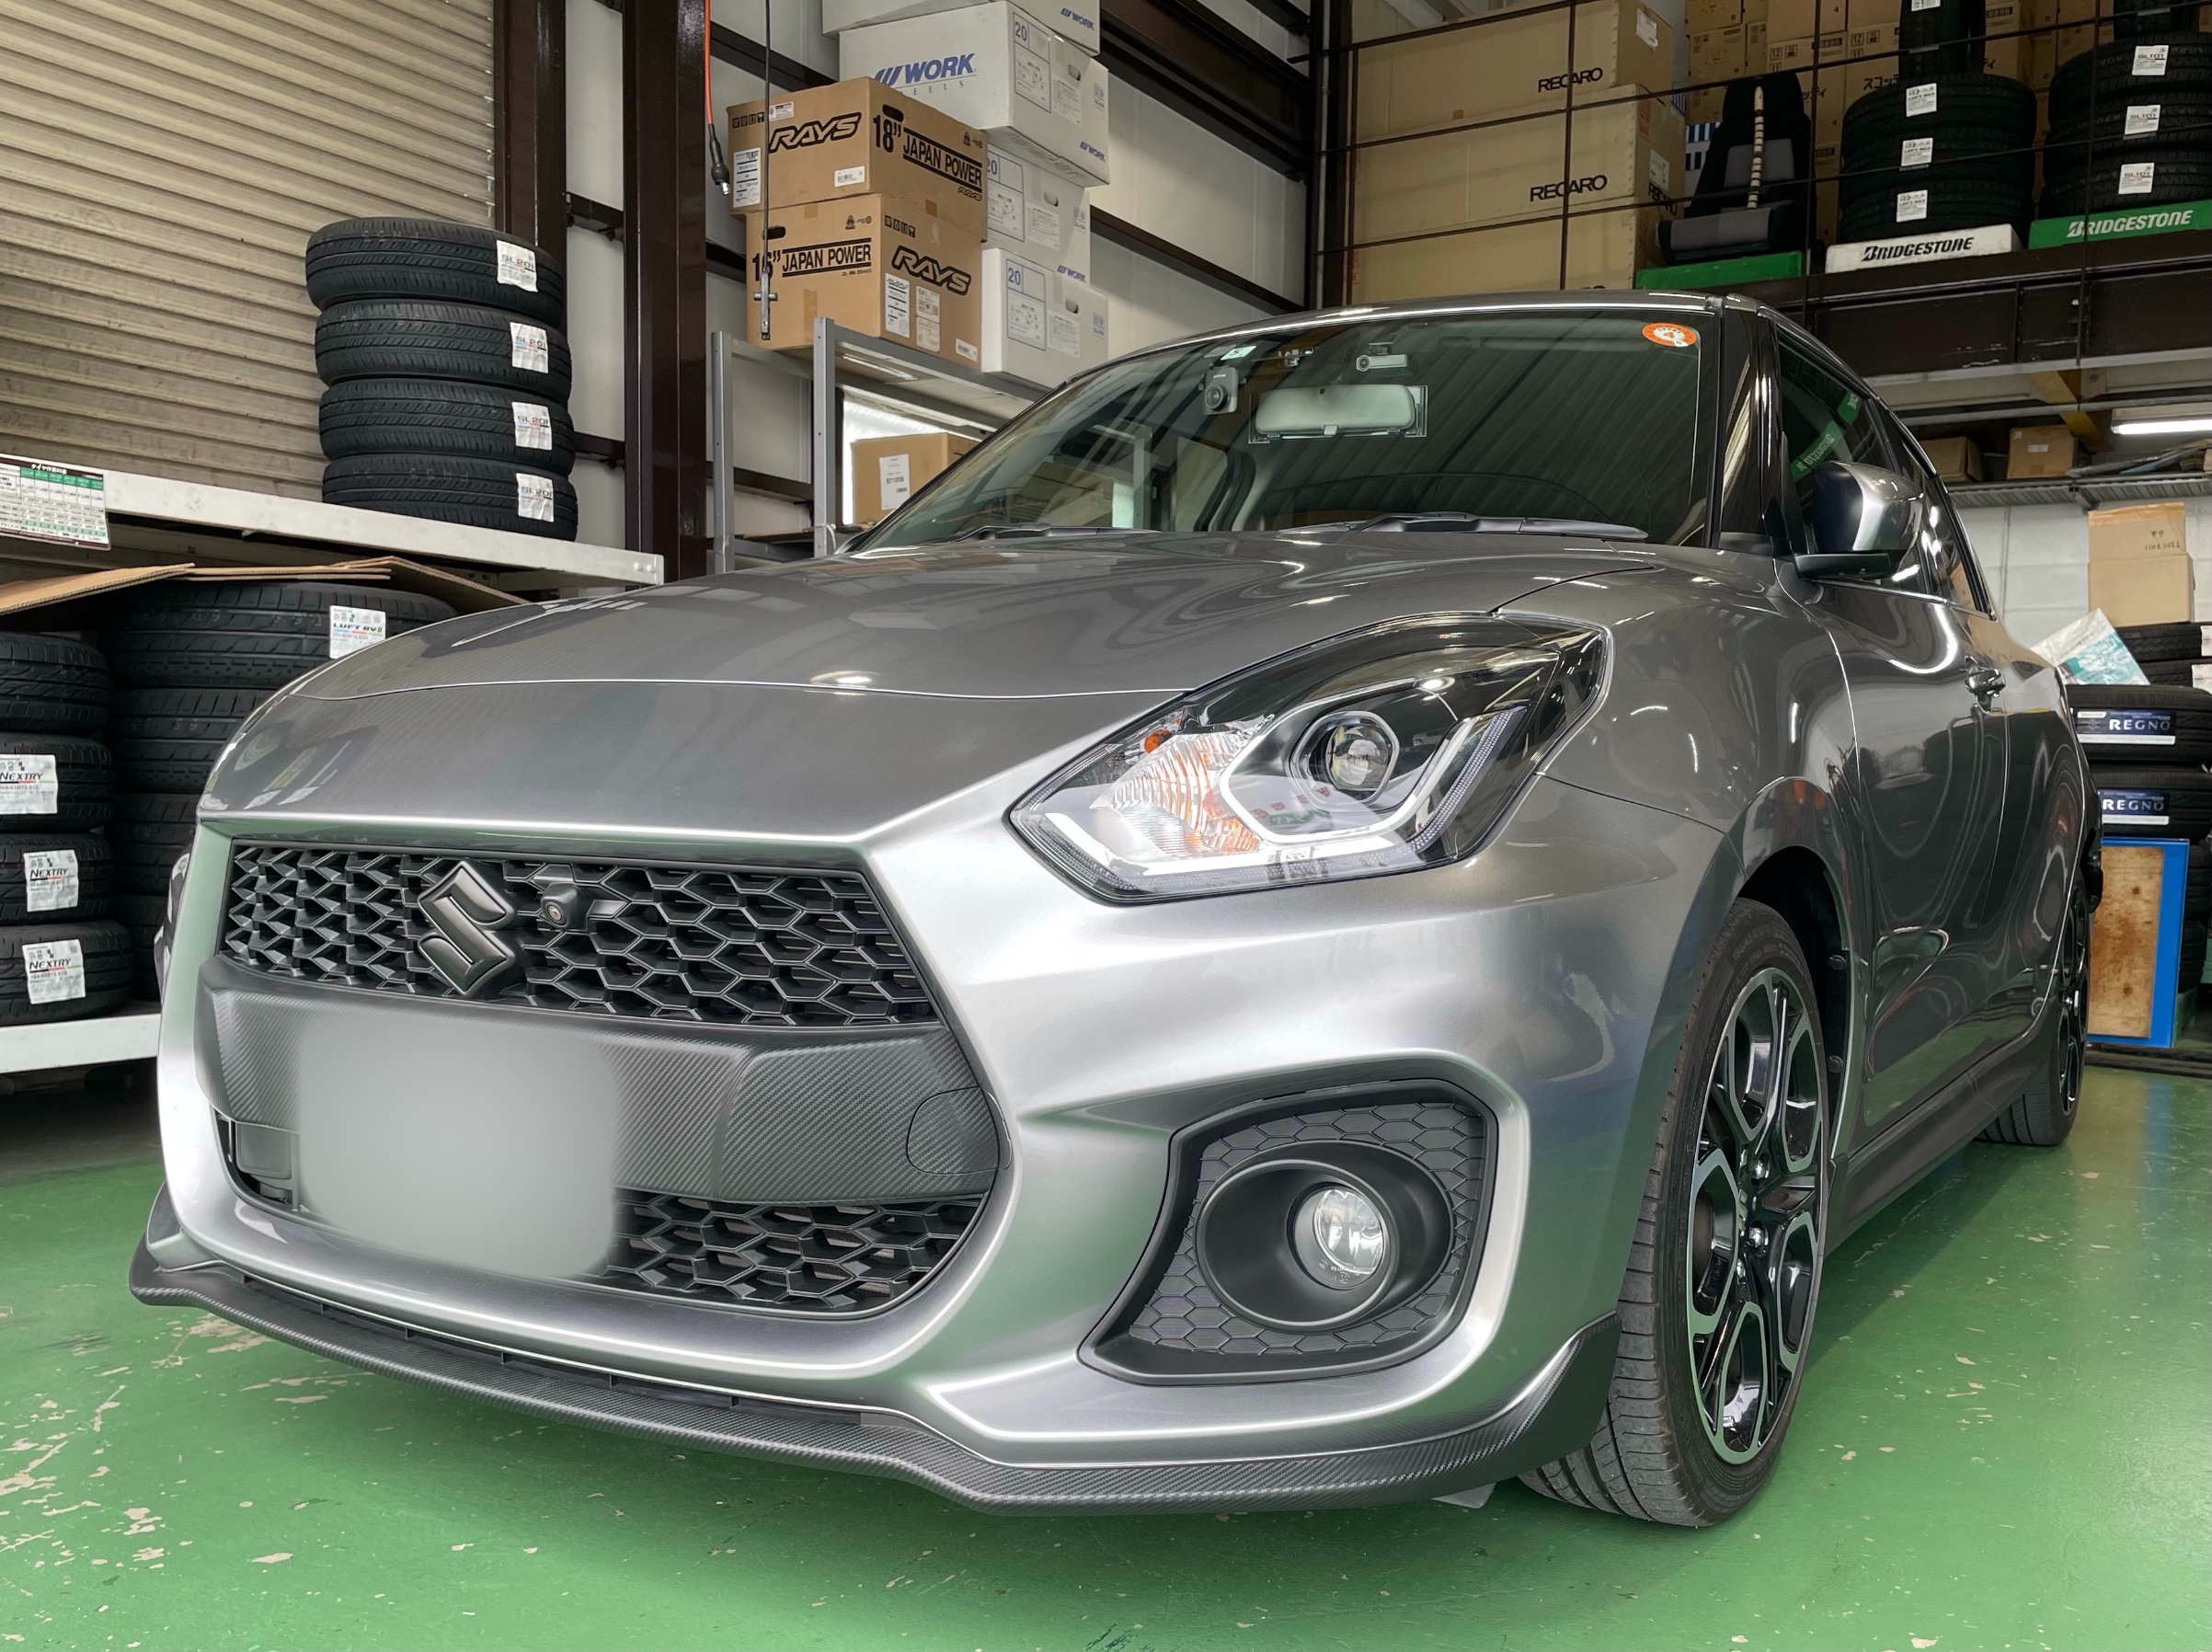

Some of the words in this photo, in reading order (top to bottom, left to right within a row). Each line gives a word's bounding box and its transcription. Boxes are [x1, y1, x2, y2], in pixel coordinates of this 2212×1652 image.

[1014, 21, 1027, 41] 20
[1072, 12, 1095, 31] WORK
[905, 52, 975, 85] WORK
[913, 81, 965, 96] EELS
[1538, 67, 1604, 93] RECARO
[769, 111, 862, 154] RAYS
[903, 134, 942, 169] JAPAN
[945, 154, 982, 188] POWER
[1530, 175, 1608, 202] RECARO
[2067, 210, 2194, 237] BRIDGESTONE
[782, 249, 823, 271] JAPAN
[828, 244, 871, 266] POWER
[1862, 237, 1975, 262] BRIDGESTONE
[891, 245, 971, 295] RAYS
[1008, 268, 1021, 285] 20
[517, 415, 549, 425] SL201
[2109, 718, 2171, 731] REGNO
[0, 773, 43, 781] NEXTRY
[2103, 798, 2164, 811] REGNO
[30, 867, 69, 878] NEXTRY
[29, 958, 71, 969] NEXTRY
